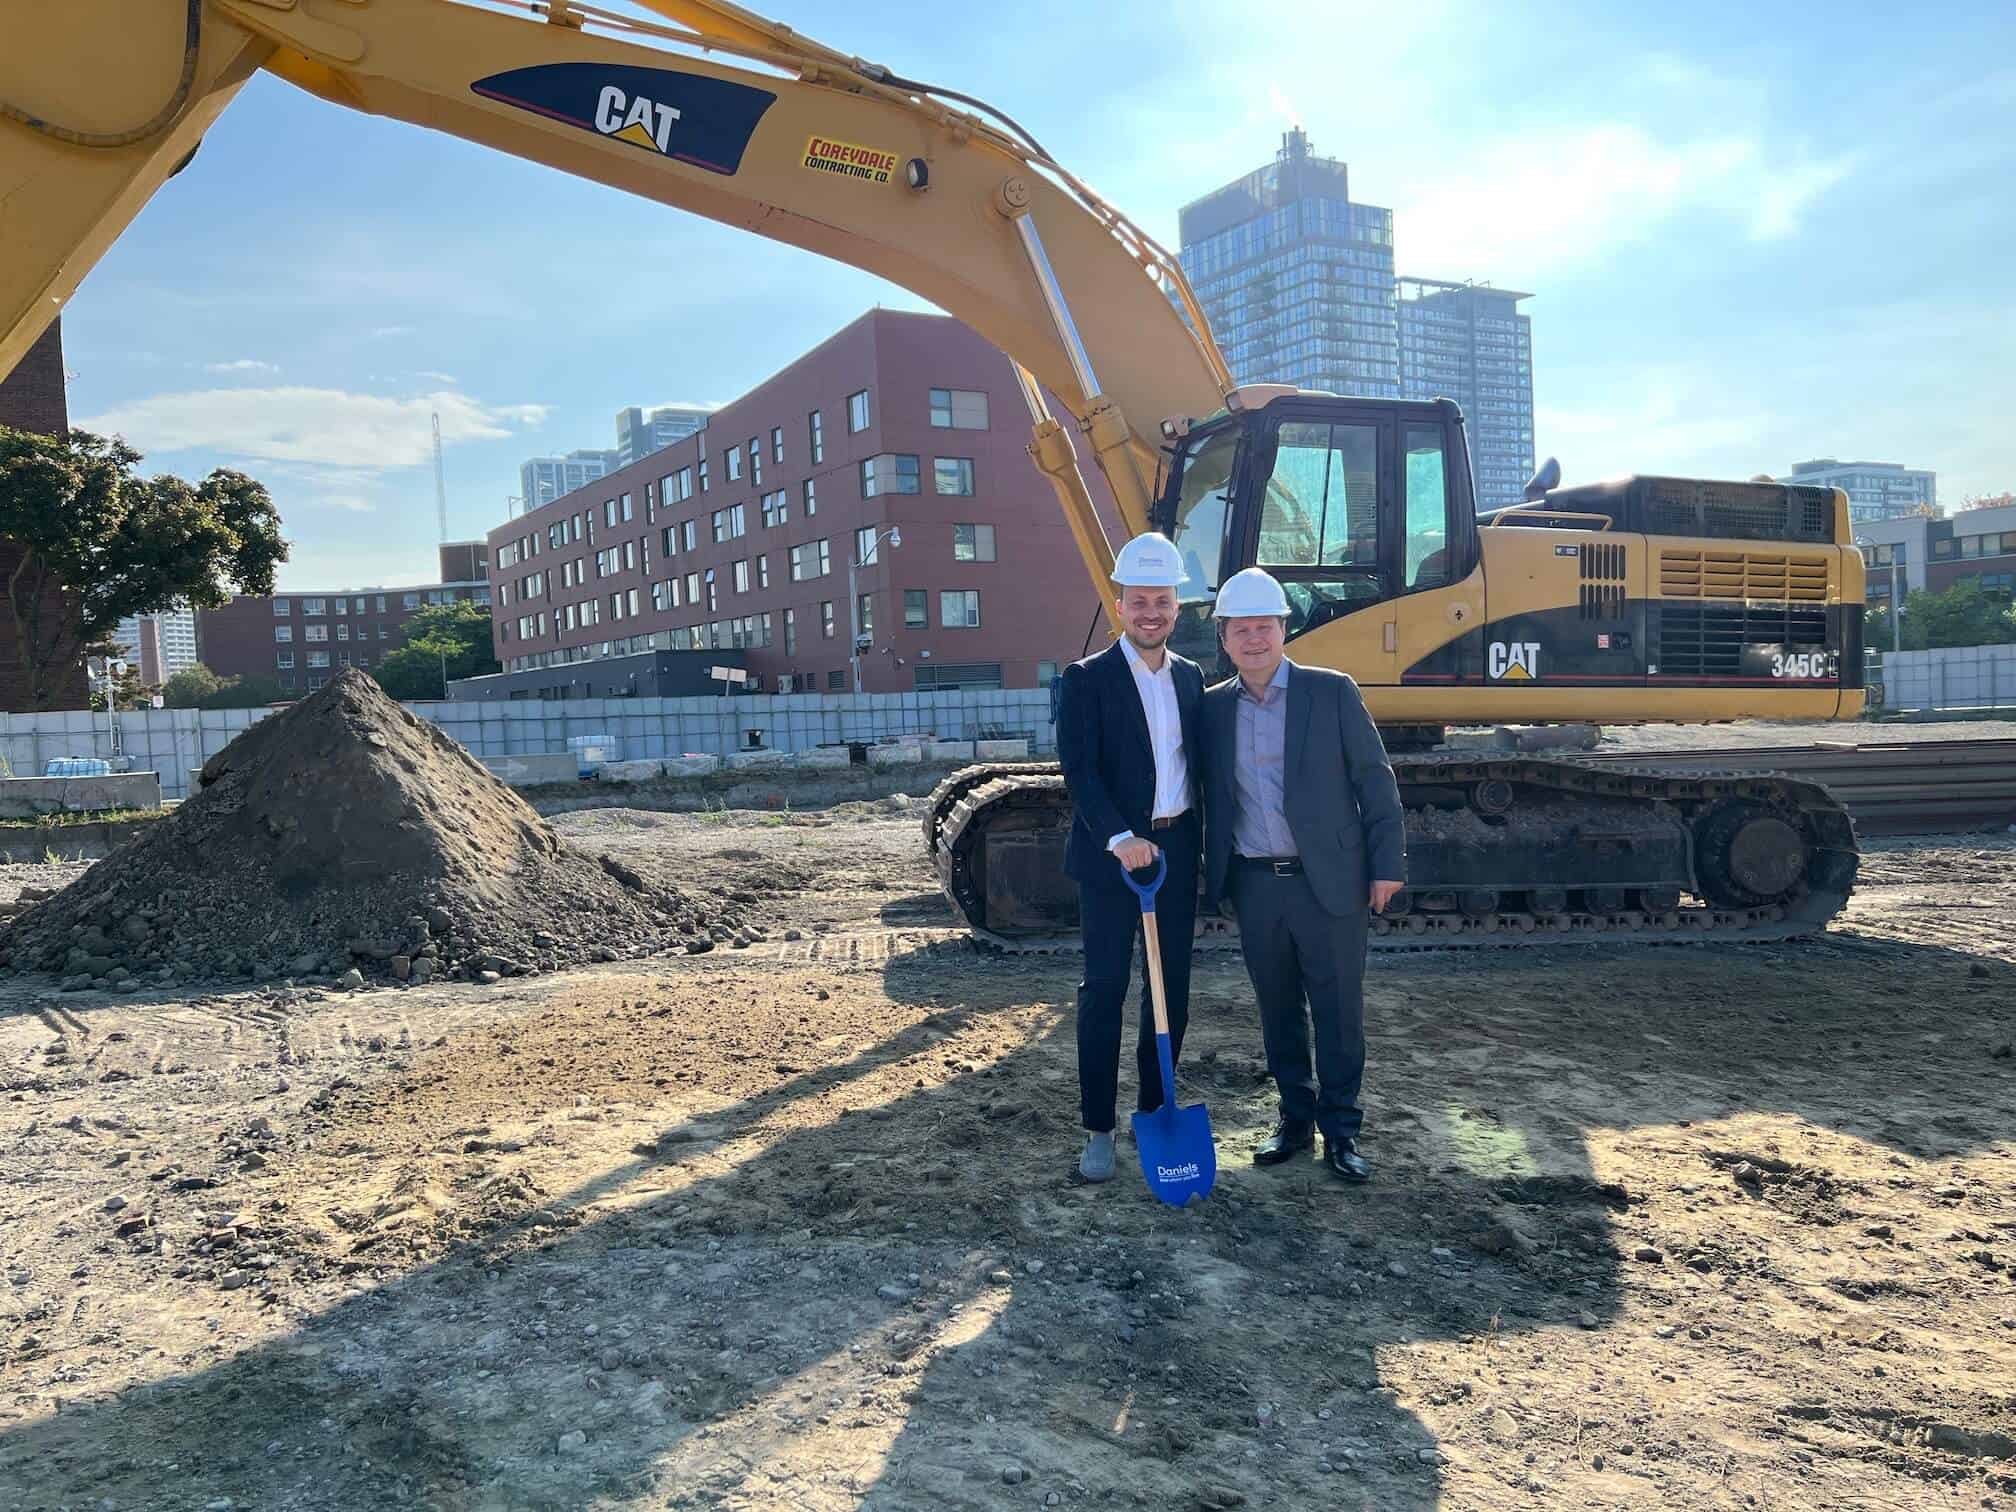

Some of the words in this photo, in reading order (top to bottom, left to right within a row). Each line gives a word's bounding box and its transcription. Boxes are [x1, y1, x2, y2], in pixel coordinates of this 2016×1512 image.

[594, 86, 681, 154] CAT
[804, 156, 873, 180] CONTRACTING
[875, 171, 889, 184] CO.
[809, 138, 896, 171] COREYDALE
[1488, 641, 1541, 680] CAT
[1157, 1162, 1199, 1177] Daniels
